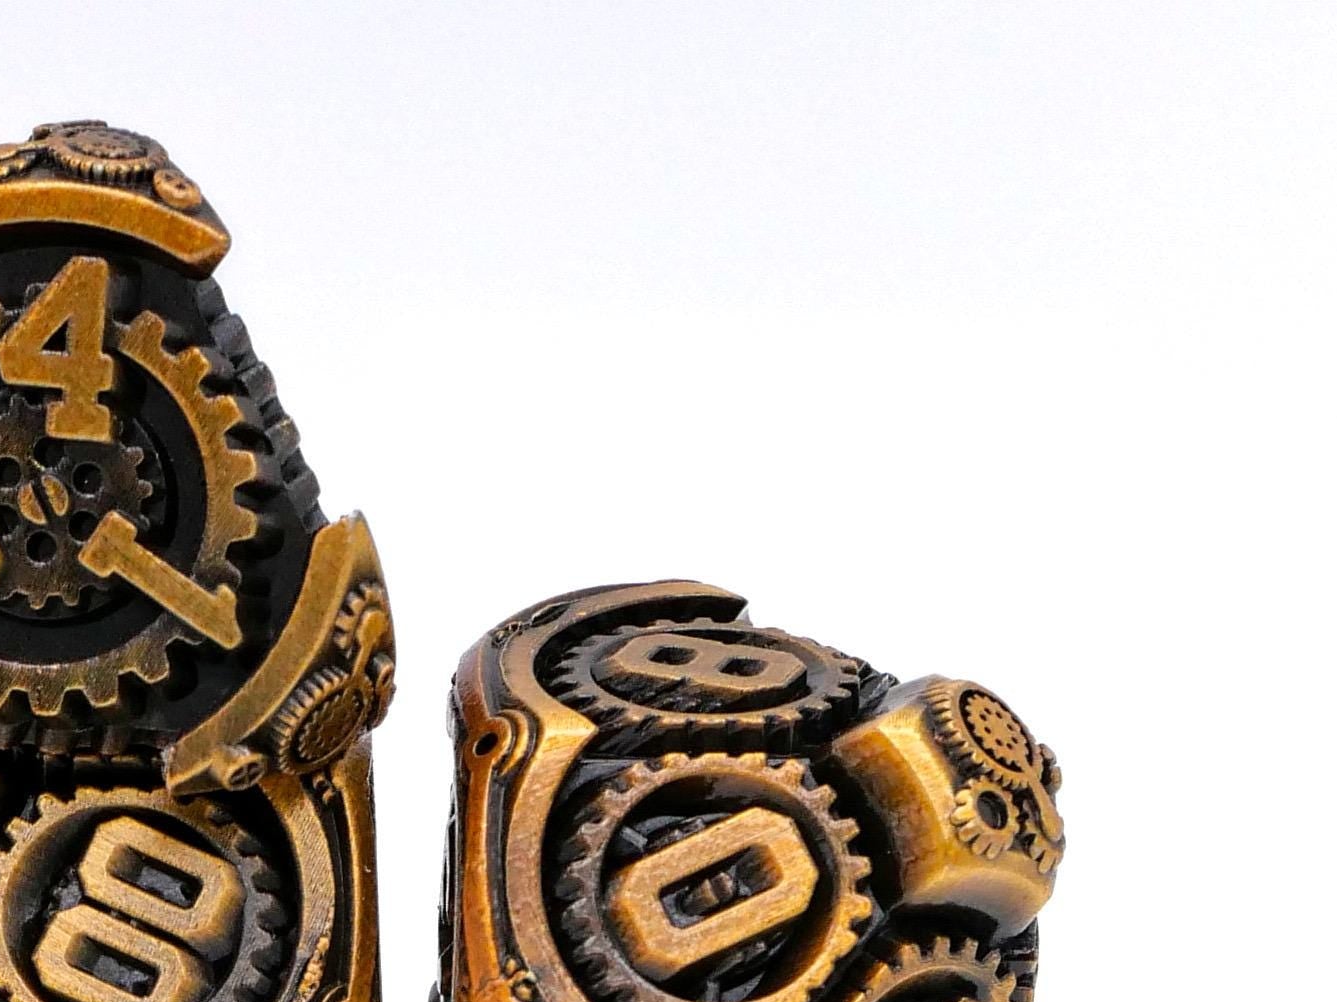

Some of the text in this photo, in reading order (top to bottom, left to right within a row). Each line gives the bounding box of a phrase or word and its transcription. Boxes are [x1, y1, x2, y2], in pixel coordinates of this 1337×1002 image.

[78, 511, 243, 650] 1
[611, 633, 807, 691] 8
[608, 806, 820, 980] 0
